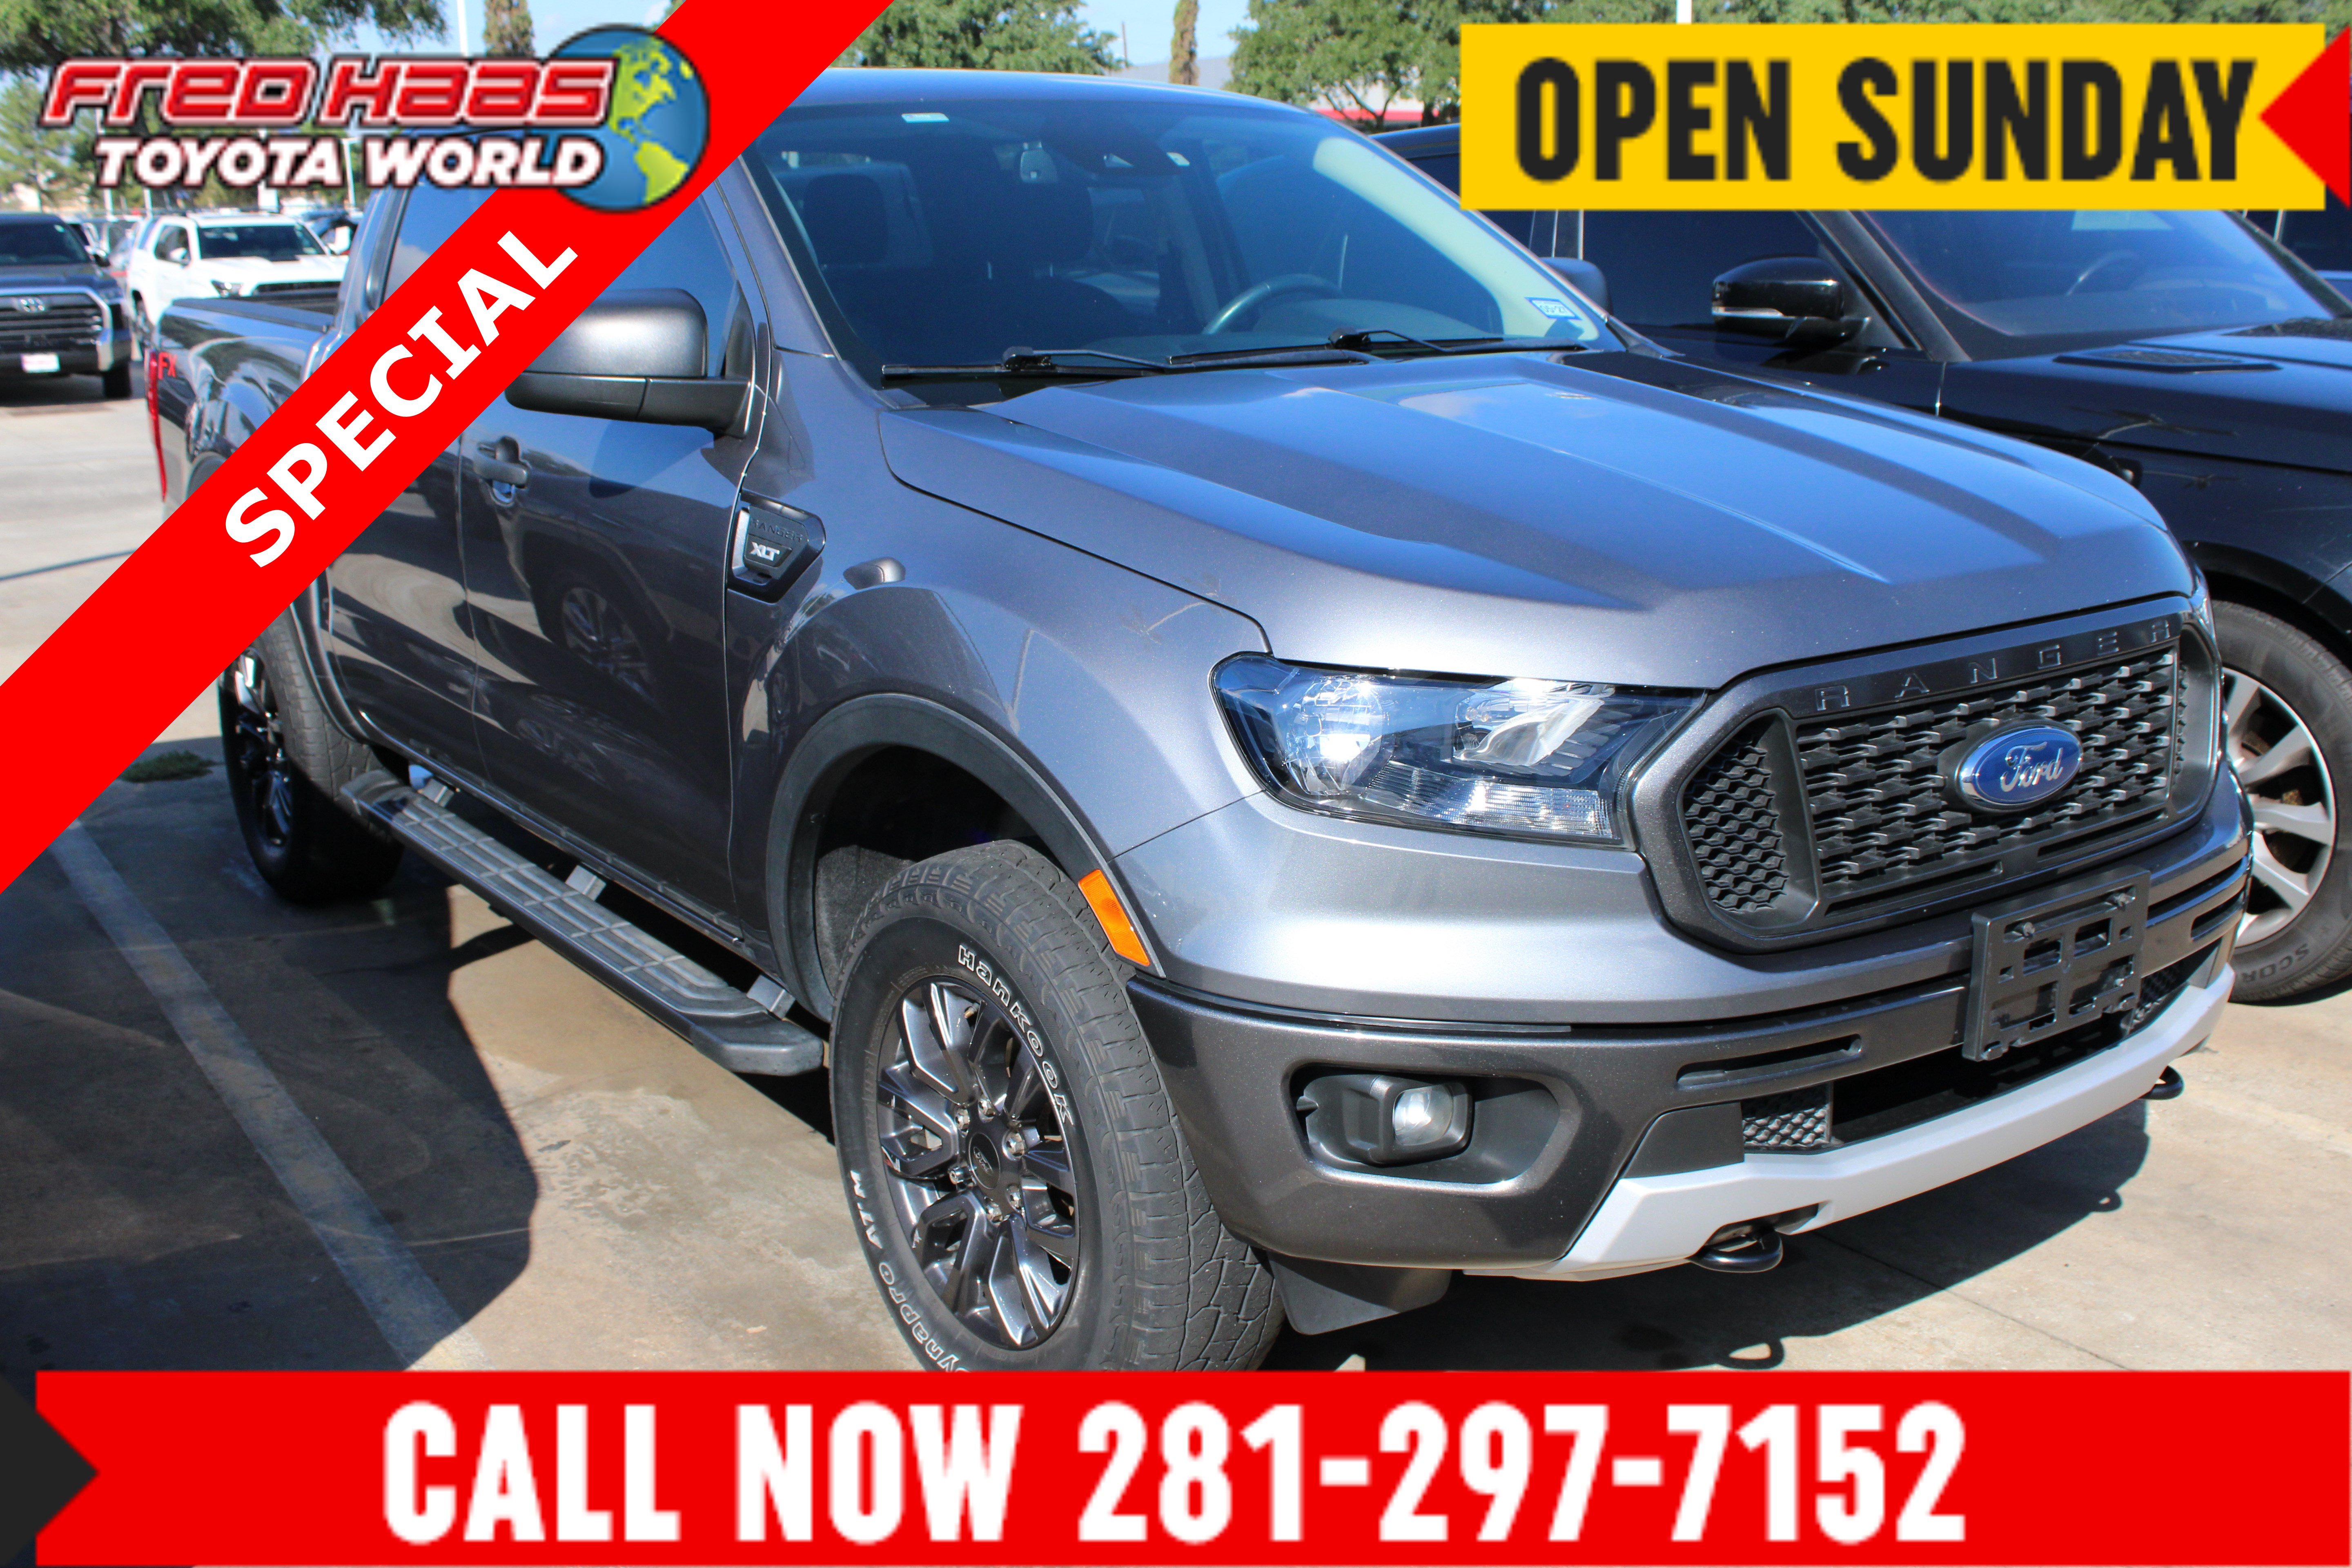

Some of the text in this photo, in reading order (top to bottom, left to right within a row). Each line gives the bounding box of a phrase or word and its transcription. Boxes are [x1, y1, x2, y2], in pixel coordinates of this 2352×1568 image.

[750, 541, 780, 561] XLT
[1814, 619, 2171, 711] RANGER
[2000, 741, 2064, 792] Ford
[878, 1262, 970, 1372] ynapro
